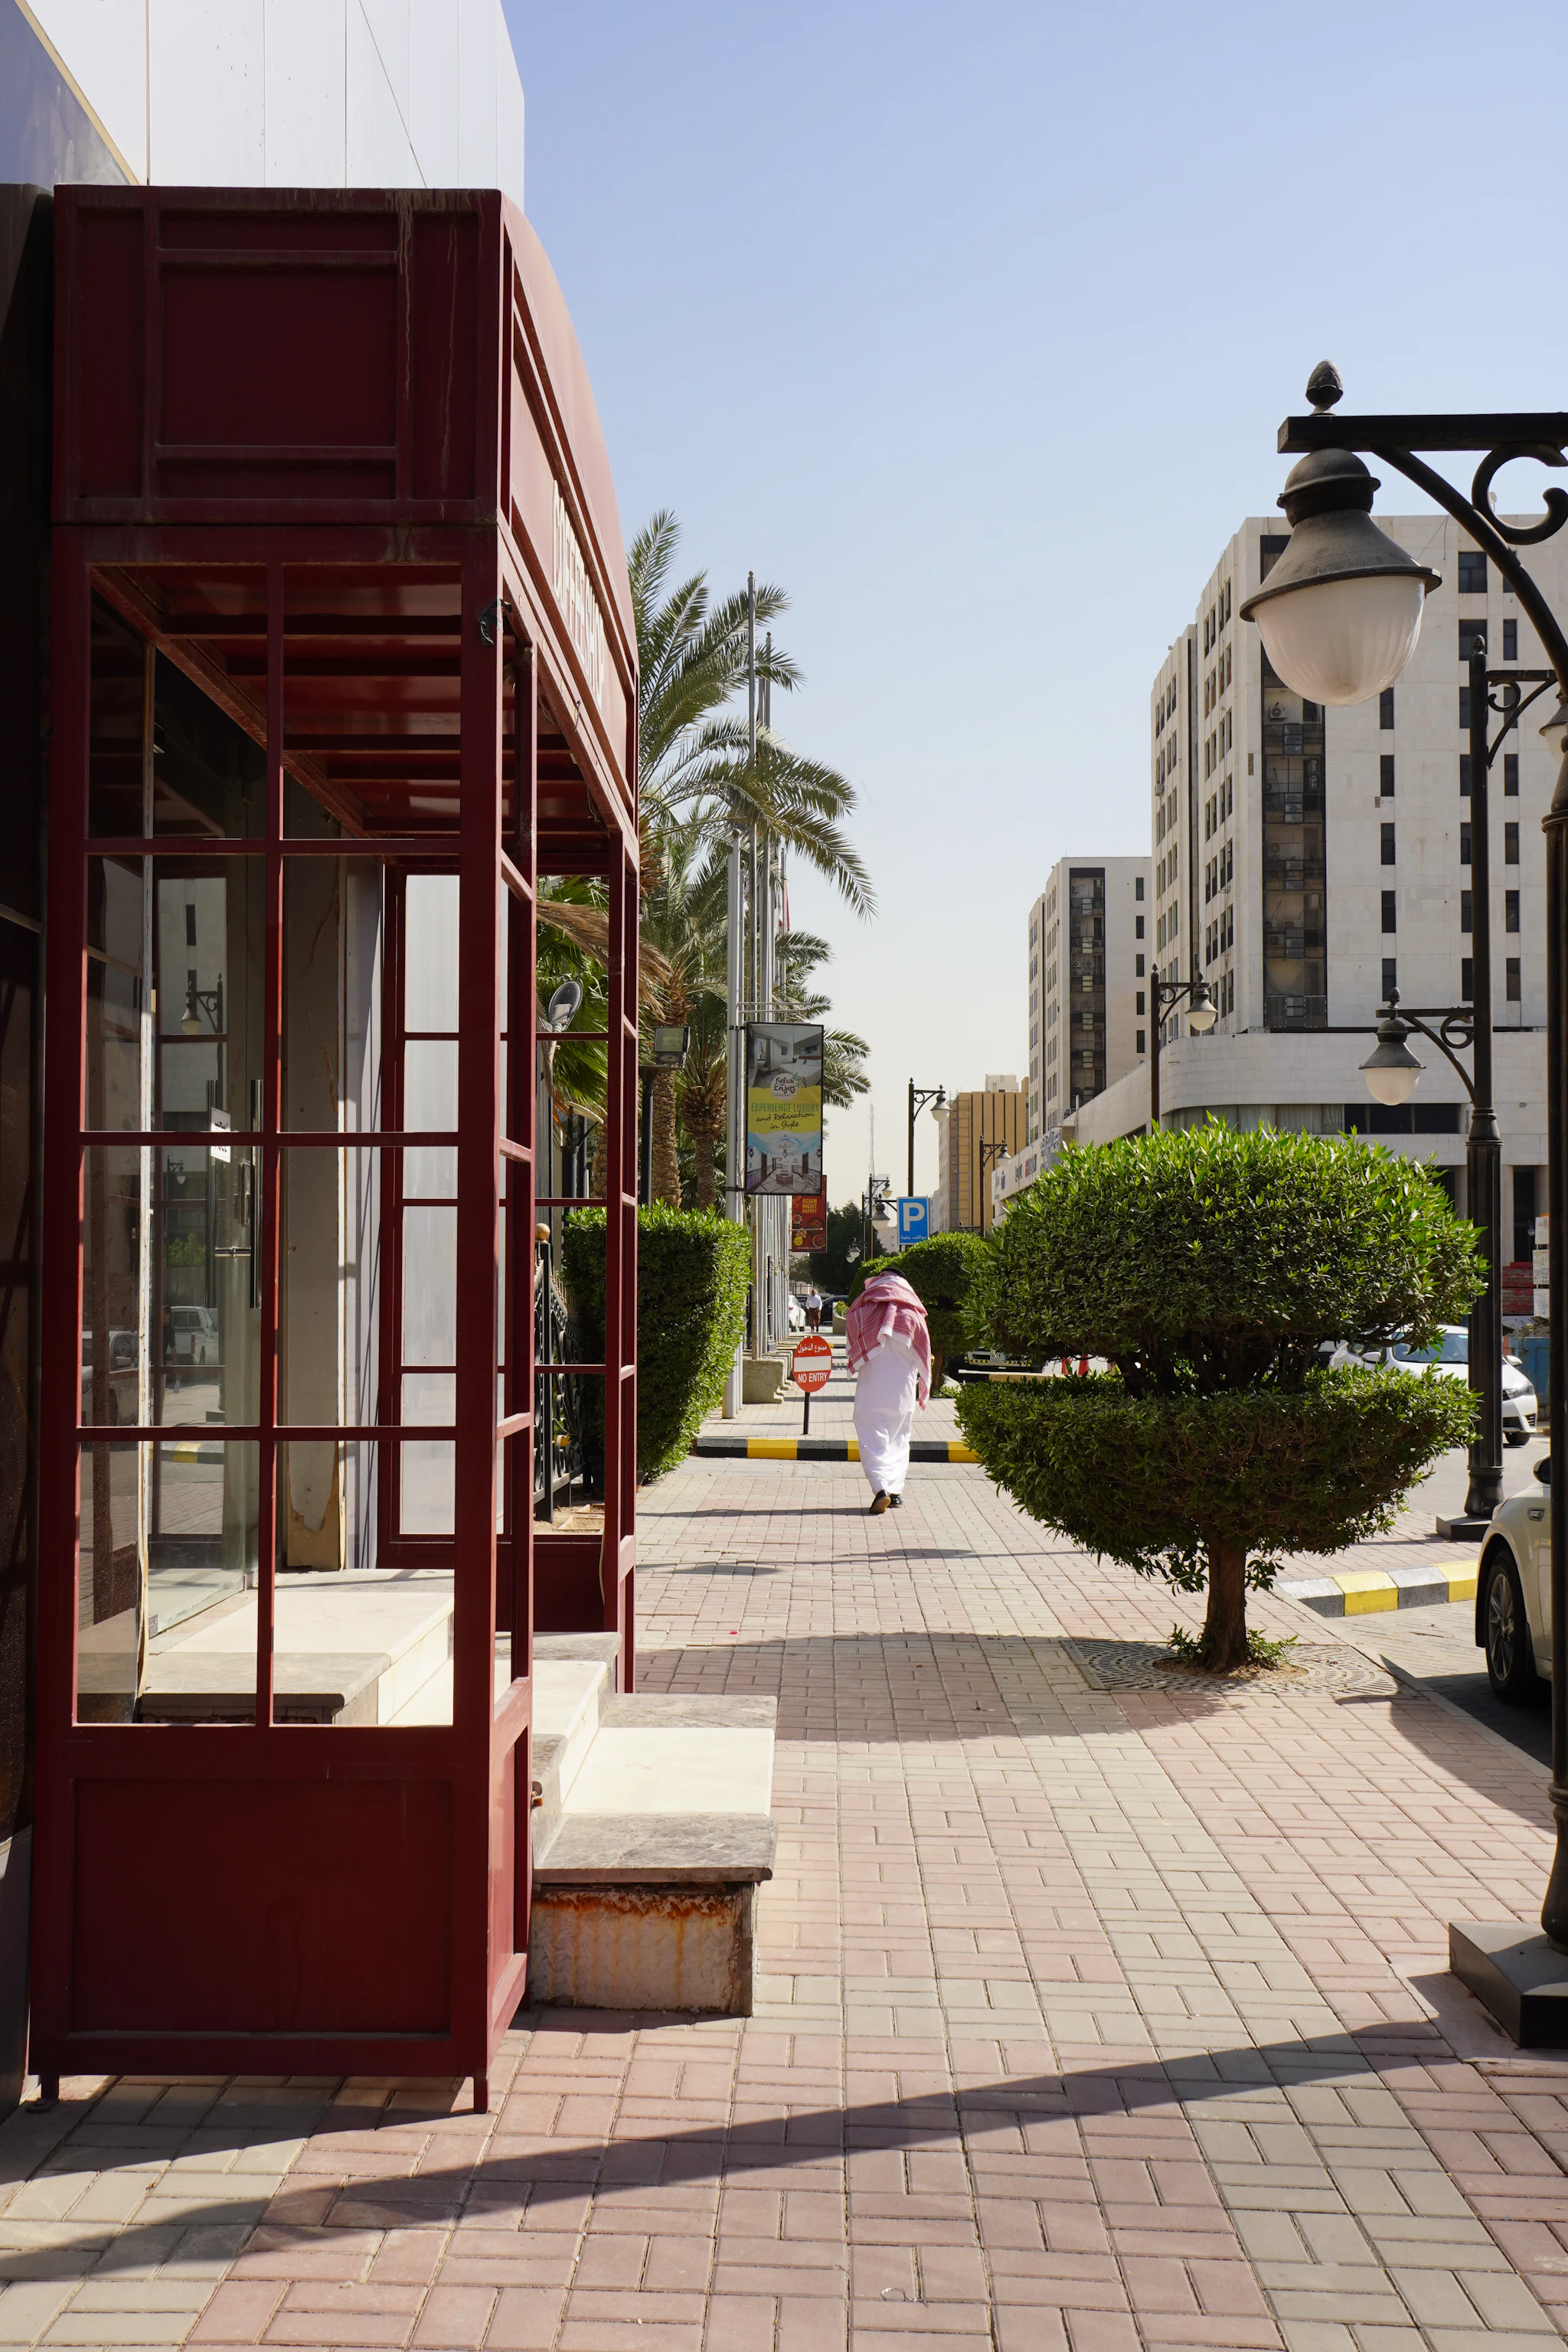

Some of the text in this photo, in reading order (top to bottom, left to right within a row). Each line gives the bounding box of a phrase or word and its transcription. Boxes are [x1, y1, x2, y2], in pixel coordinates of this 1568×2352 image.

[553, 479, 604, 711] COFFEE SHOP
[774, 1083, 795, 1094] Enjoy
[751, 1102, 820, 1112] EXPERIENCE LUXURY
[756, 1110, 815, 1122] and Relaxation
[781, 1120, 800, 1130] Style
[903, 1202, 925, 1231] P
[798, 1343, 827, 1354] ممنوع الدخول
[798, 1372, 828, 1383] NO ENTRY
